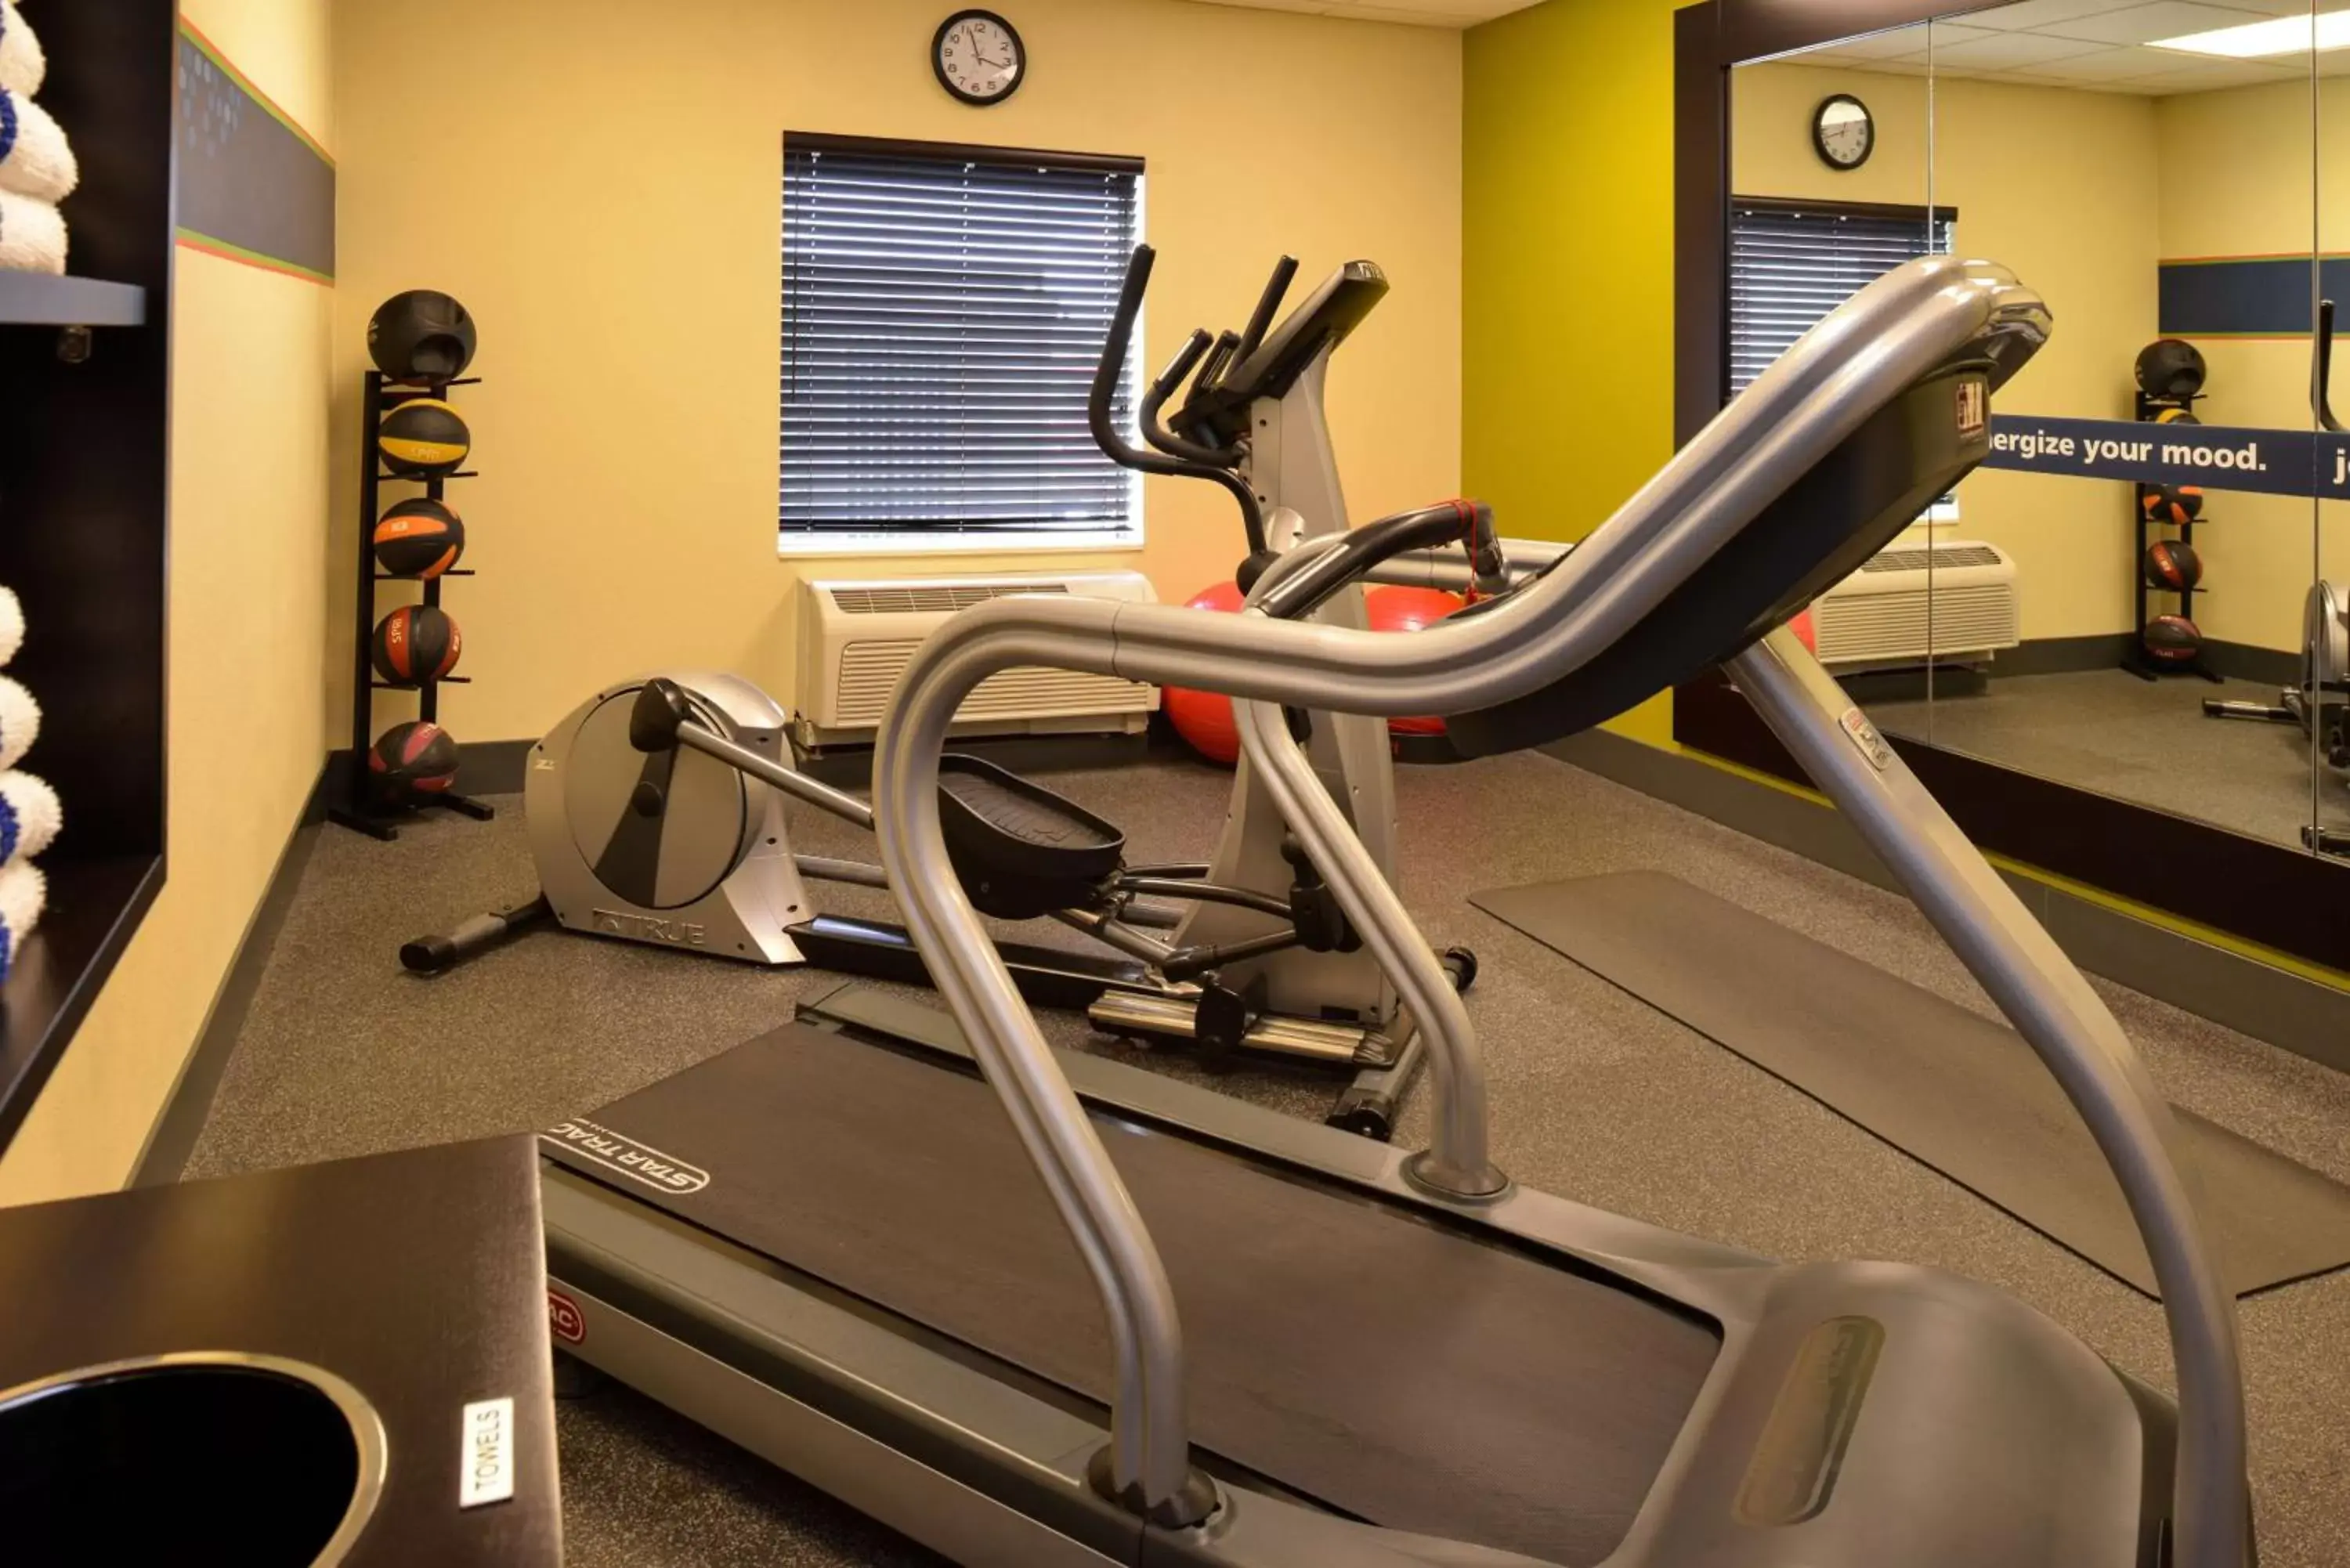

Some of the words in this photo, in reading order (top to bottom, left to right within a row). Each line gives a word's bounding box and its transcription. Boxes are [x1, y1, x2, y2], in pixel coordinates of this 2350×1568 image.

[1989, 429, 2075, 459] ergize
[2083, 439, 2153, 464] your
[2162, 443, 2266, 471] mood.
[548, 1122, 623, 1157] TRAC
[616, 1150, 691, 1187] STAR
[475, 1409, 500, 1491] TOWELS
